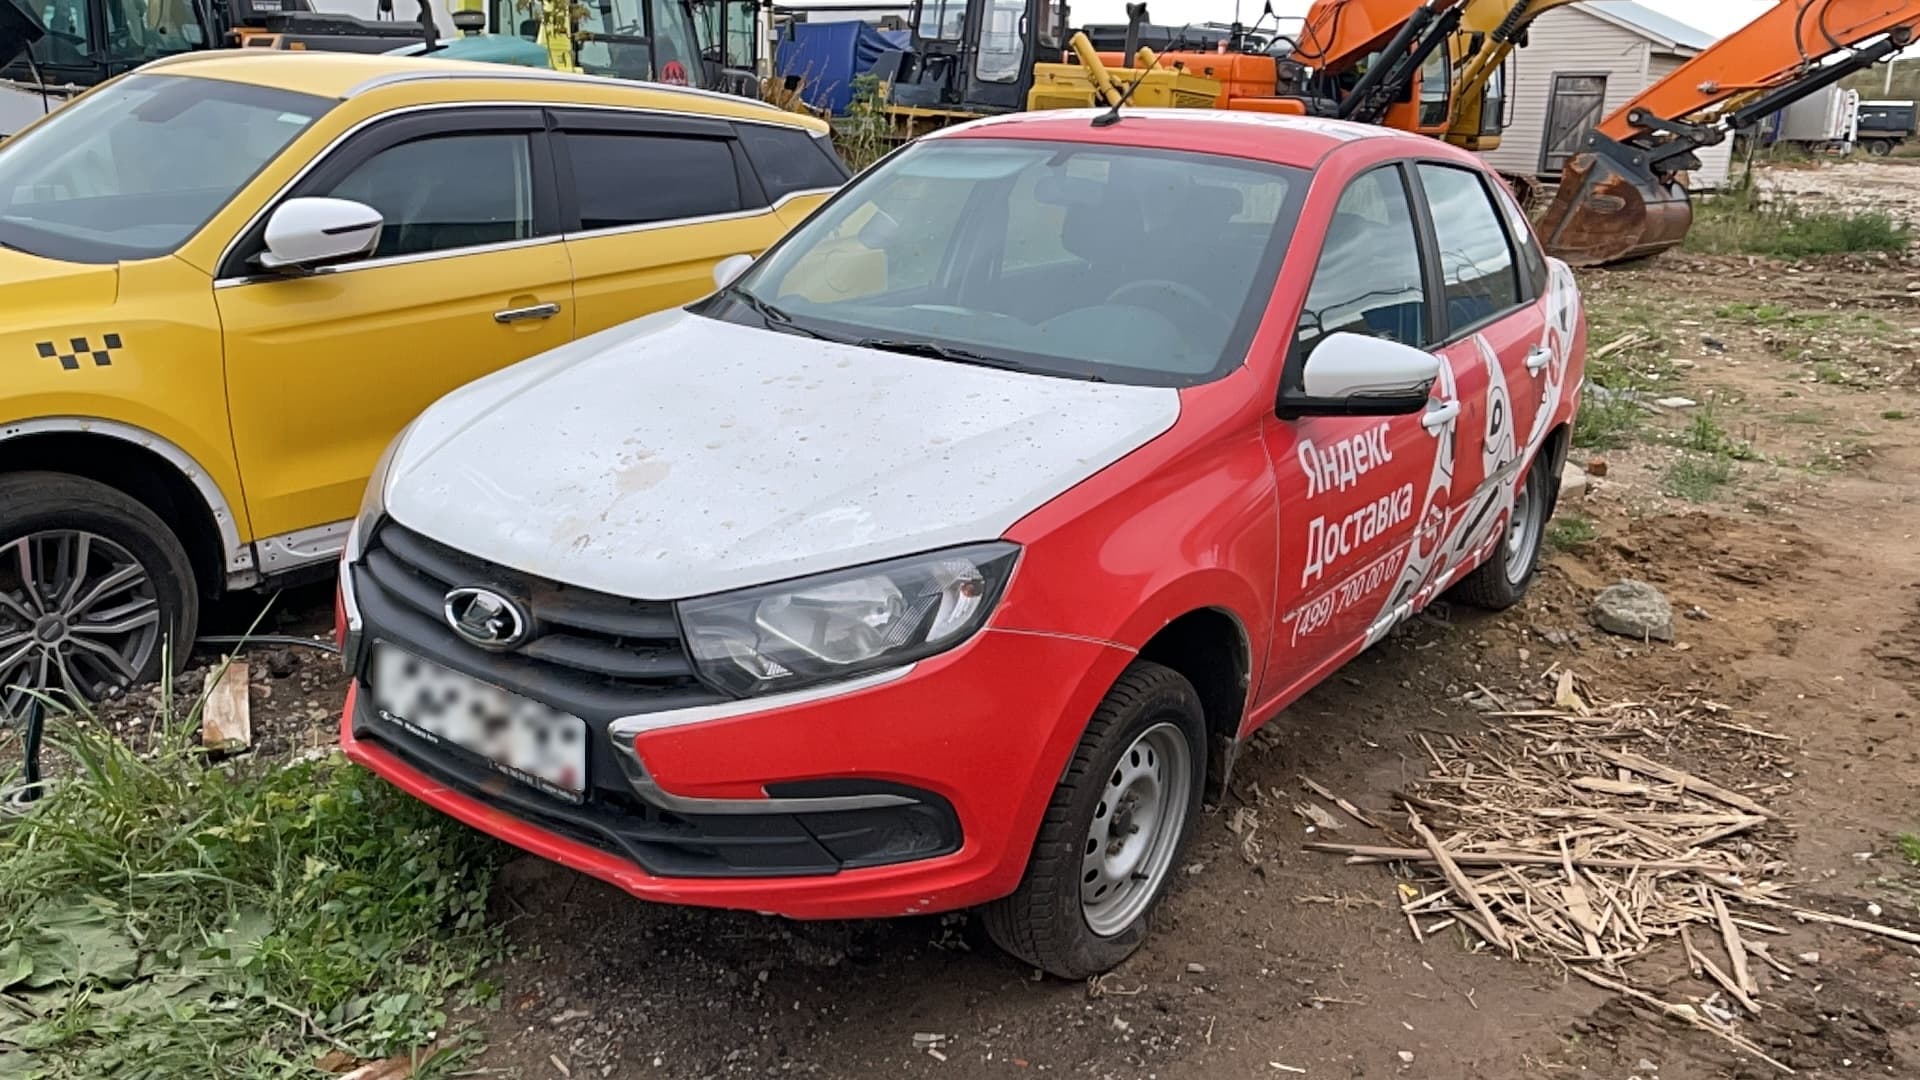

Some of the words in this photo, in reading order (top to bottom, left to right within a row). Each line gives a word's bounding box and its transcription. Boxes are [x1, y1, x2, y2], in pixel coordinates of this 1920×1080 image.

[1298, 422, 1392, 499] Яндекс
[1302, 483, 1412, 588] Доставка
[1291, 592, 1336, 648] (499)
[1336, 575, 1365, 613] 700
[1365, 561, 1385, 593] 00
[1385, 550, 1403, 580] 07
